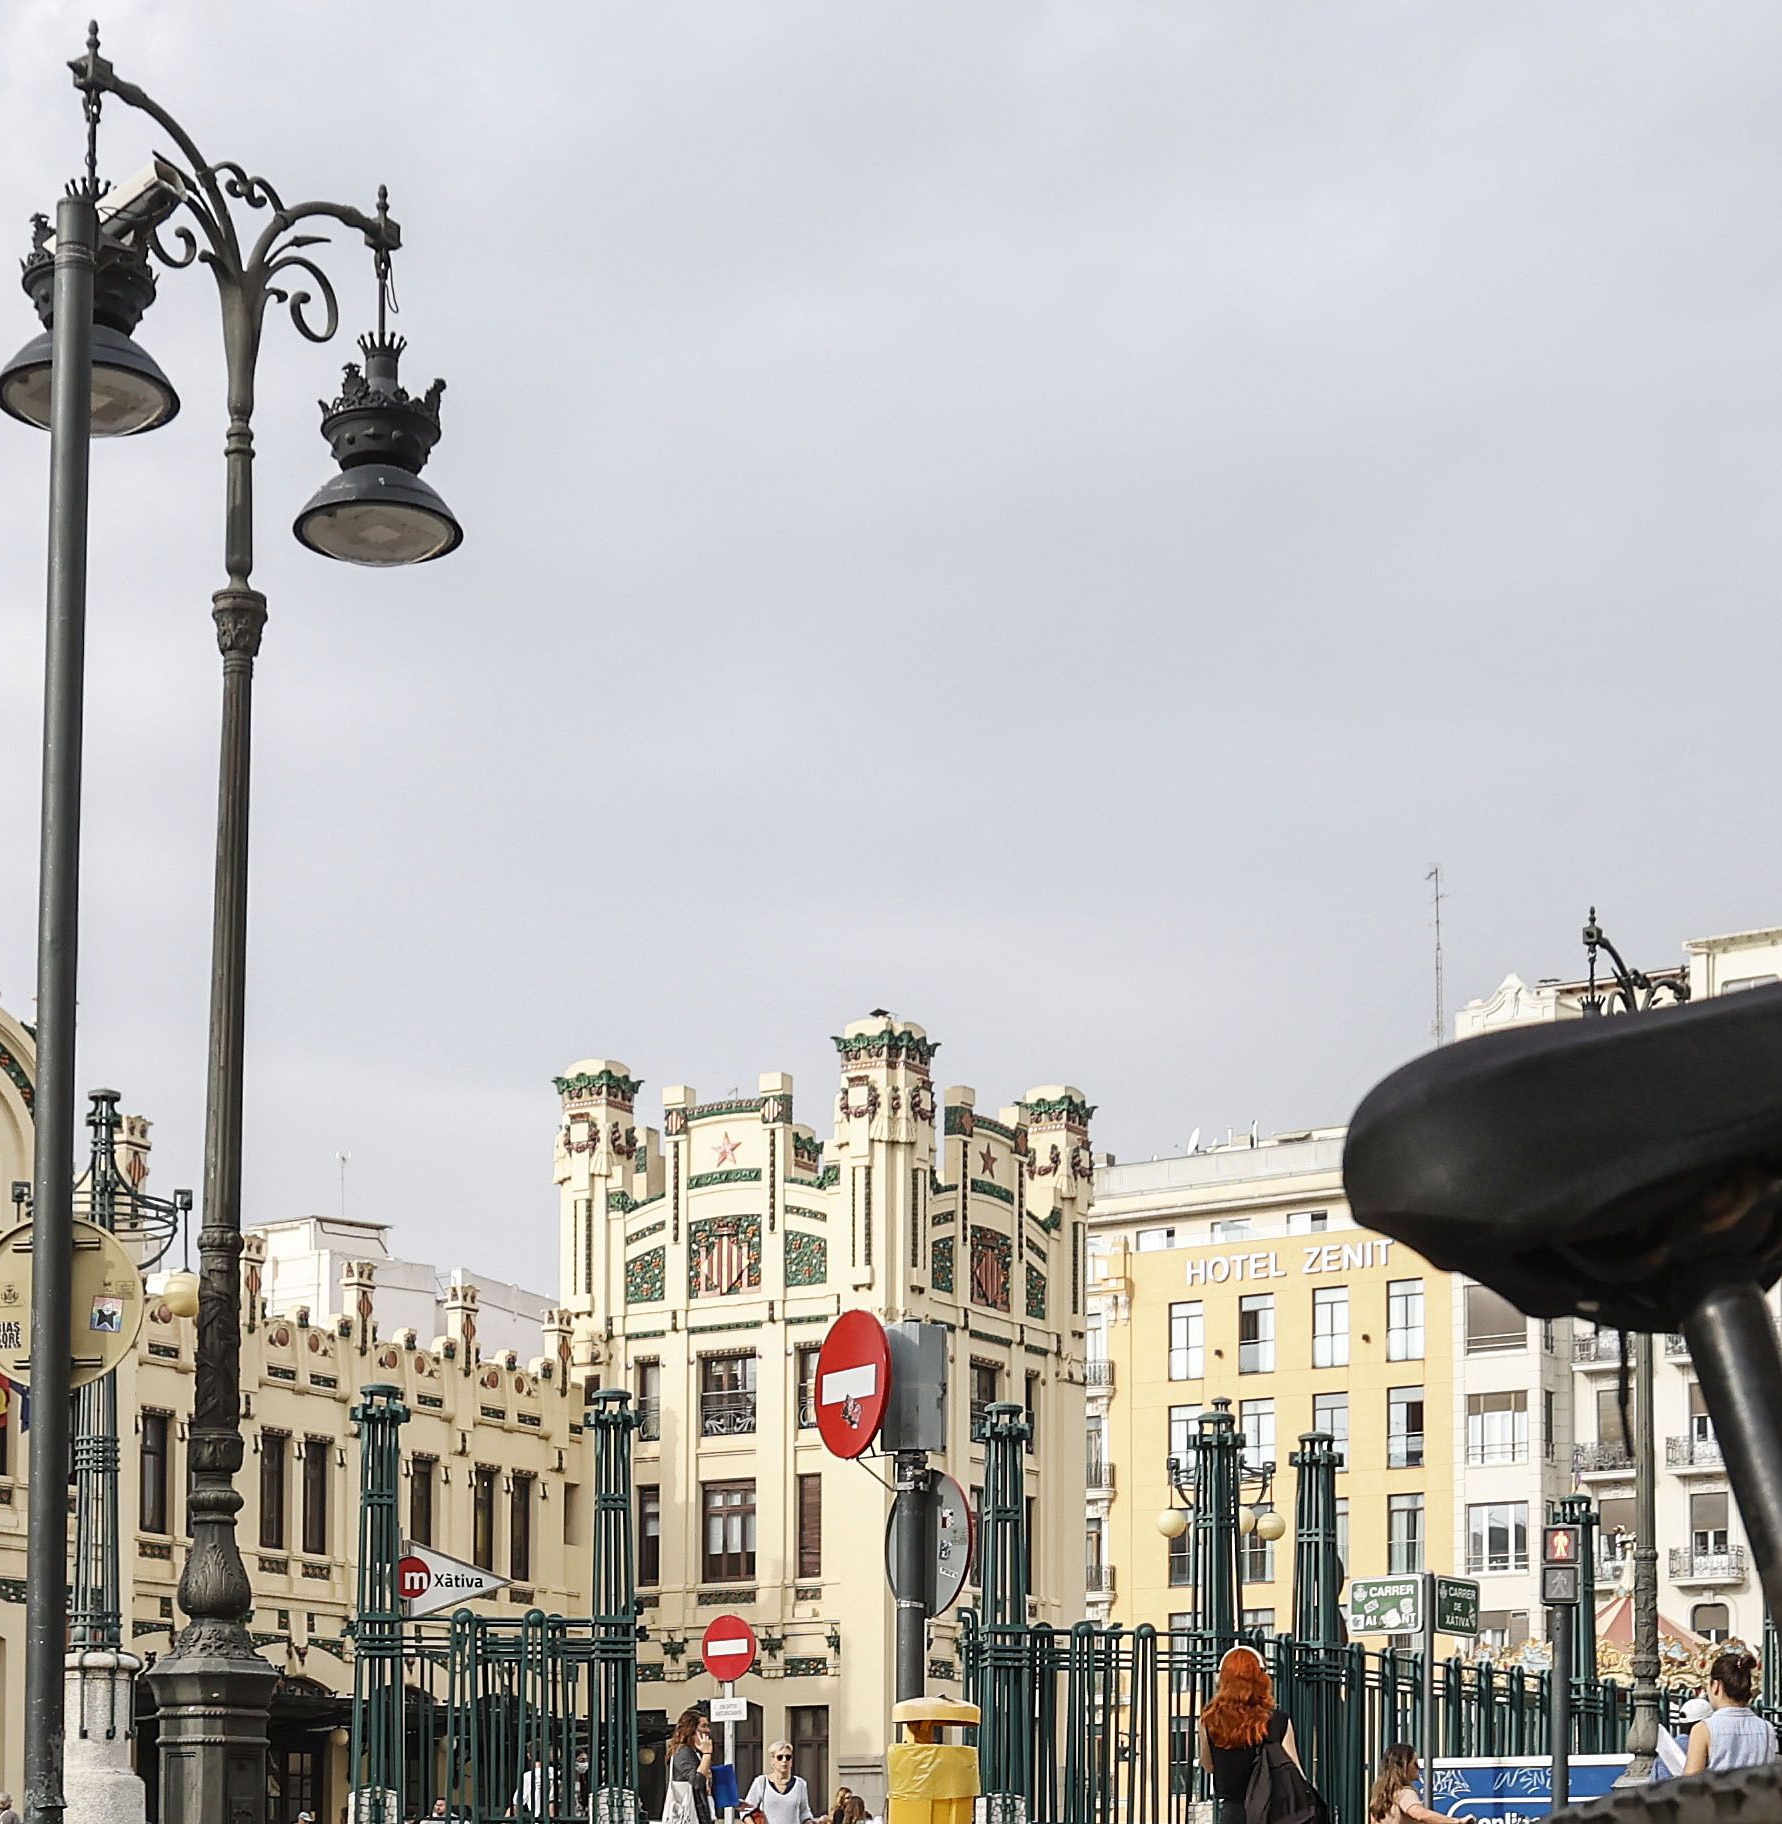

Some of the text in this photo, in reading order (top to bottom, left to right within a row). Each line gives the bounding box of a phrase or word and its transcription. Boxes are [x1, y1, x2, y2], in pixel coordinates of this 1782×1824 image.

[1186, 1238, 1395, 1286] HOTEL ZENIT
[434, 1573, 484, 1588] Xàtiva
[1369, 1584, 1414, 1598] CARRER
[1448, 1586, 1476, 1600] CARRER
[1453, 1601, 1462, 1612] DE
